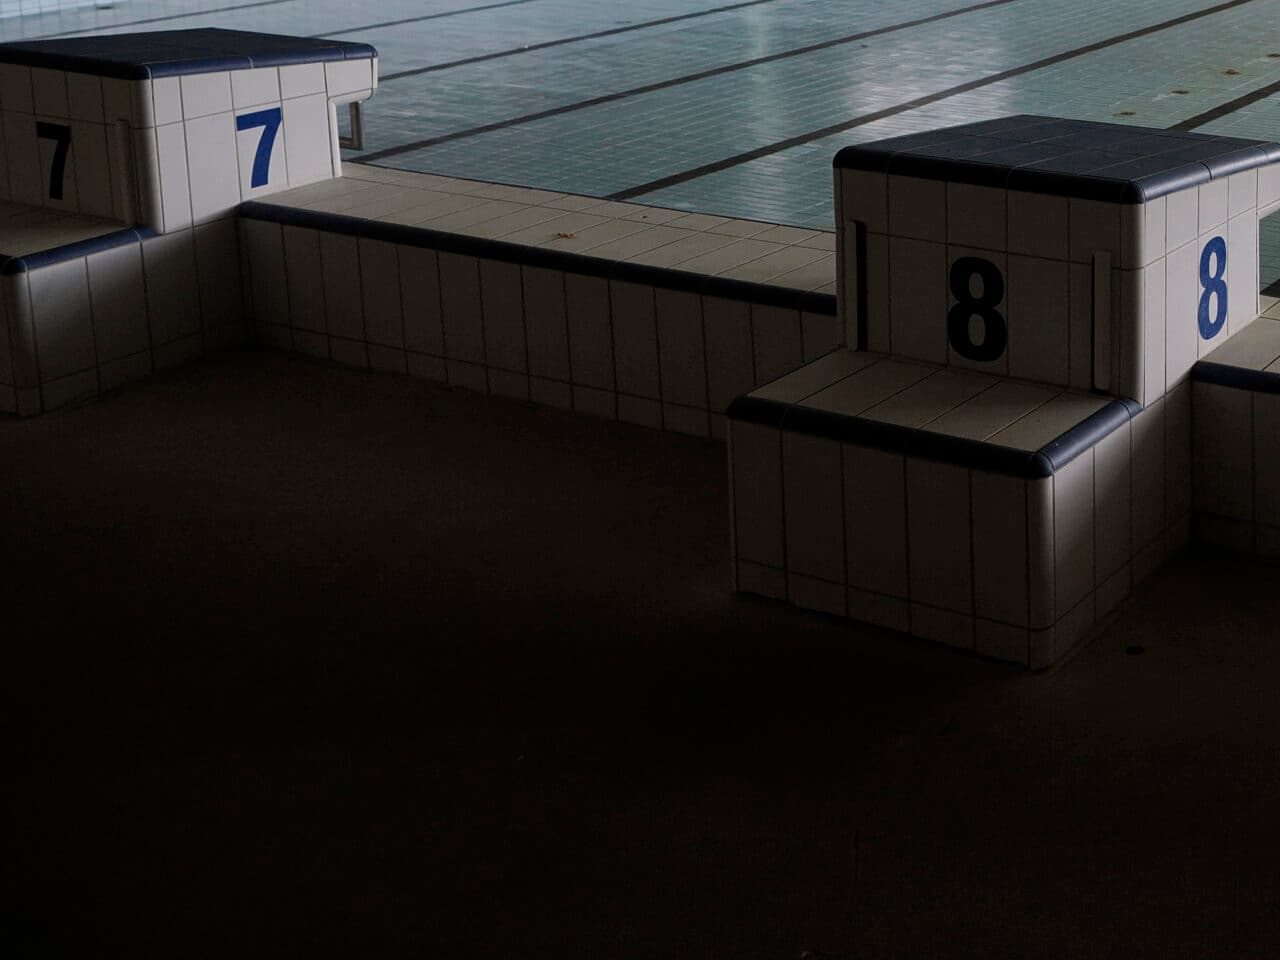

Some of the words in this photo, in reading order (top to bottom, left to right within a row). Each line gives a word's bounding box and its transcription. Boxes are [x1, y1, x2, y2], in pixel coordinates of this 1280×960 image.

[36, 121, 71, 200] 7
[236, 107, 282, 188] 7
[948, 257, 1008, 362] 8
[1198, 236, 1228, 340] 8
